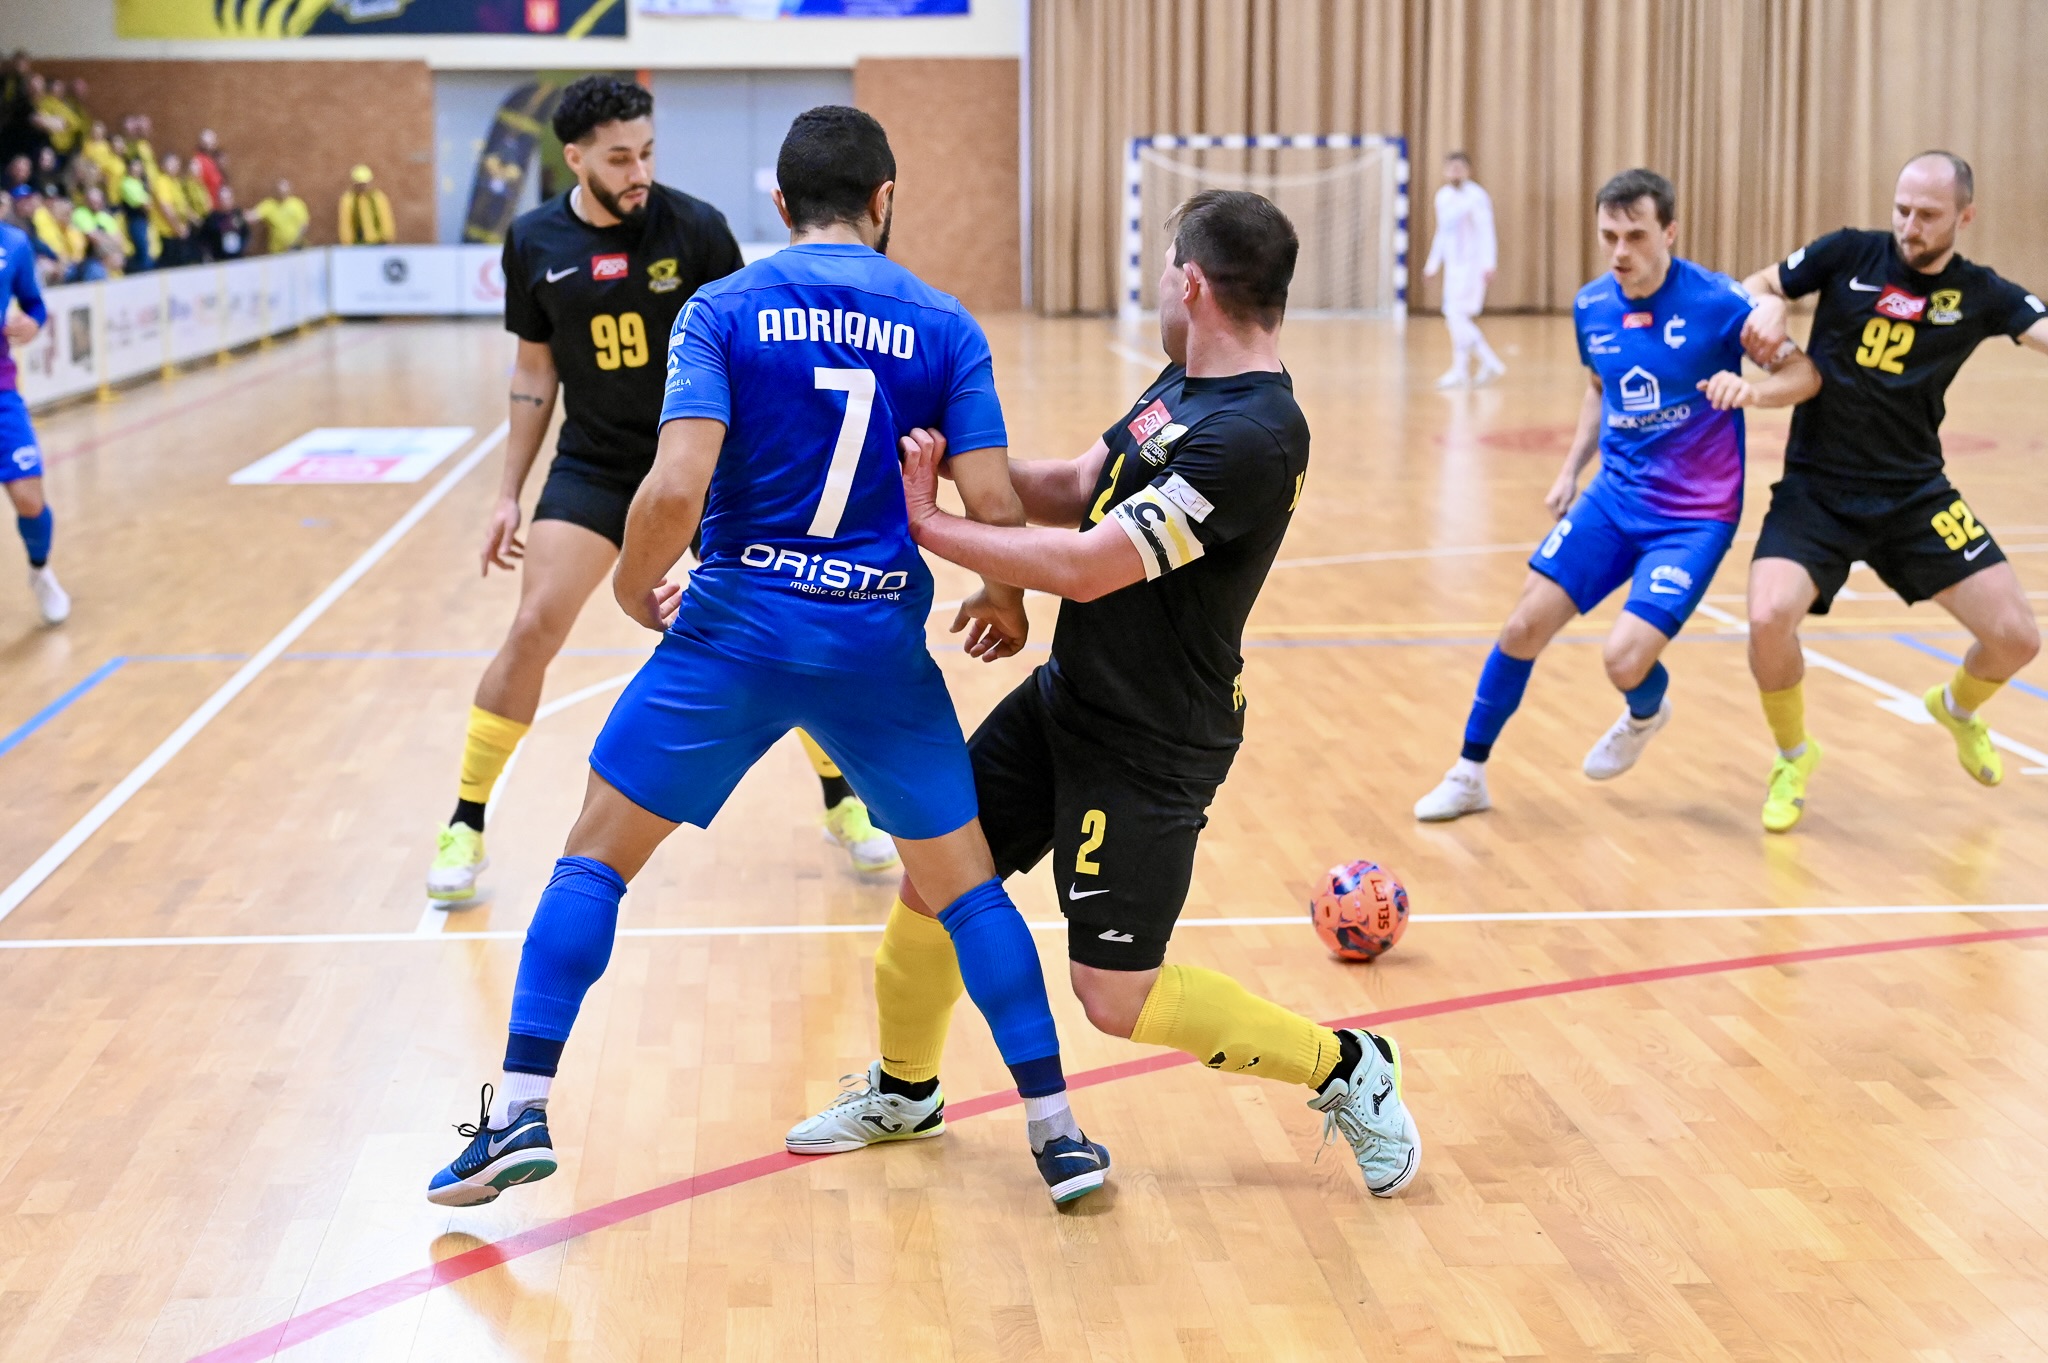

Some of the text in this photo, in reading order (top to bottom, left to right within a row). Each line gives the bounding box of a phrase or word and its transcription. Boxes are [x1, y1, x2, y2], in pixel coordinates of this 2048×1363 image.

[590, 311, 649, 371] 99
[758, 307, 915, 360] ADRIANO
[1856, 317, 1916, 375] 92
[806, 366, 876, 539] 7
[1133, 502, 1166, 530] C
[1541, 519, 1573, 559] 6
[1931, 500, 1985, 550] 92
[790, 581, 828, 595] meble
[1075, 809, 1107, 876] 2
[1370, 879, 1390, 930] SELECT
